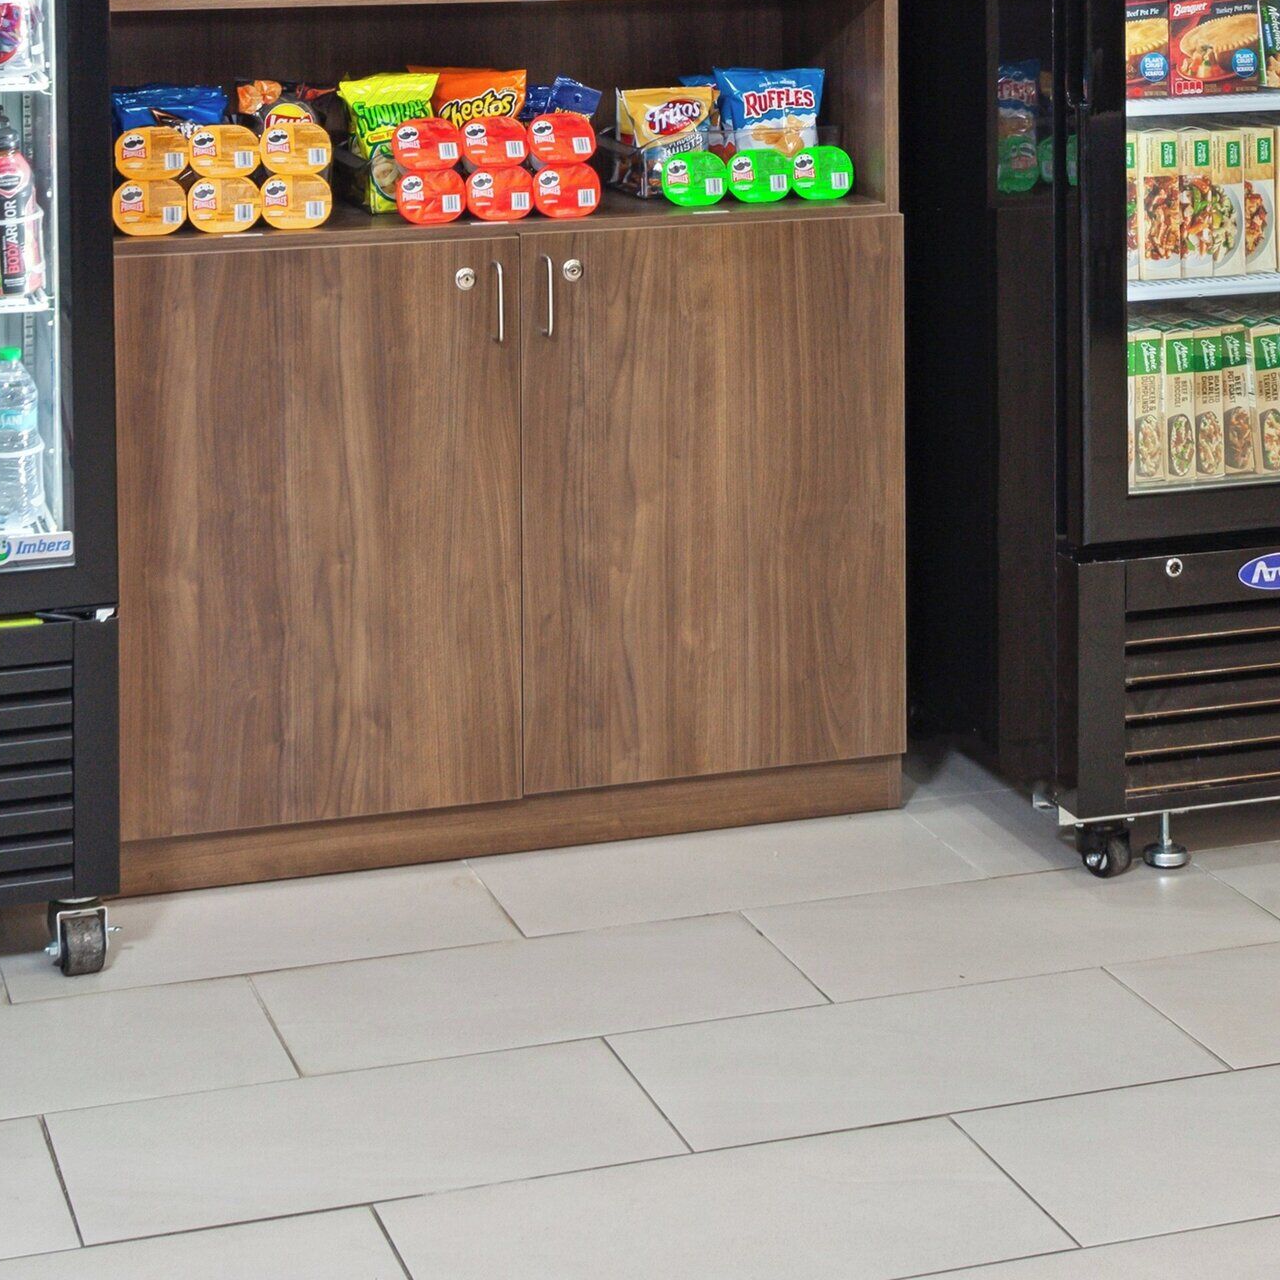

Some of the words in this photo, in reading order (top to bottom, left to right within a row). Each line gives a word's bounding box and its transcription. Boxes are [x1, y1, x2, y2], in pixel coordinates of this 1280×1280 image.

[1140, 8, 1149, 16] Pot
[1150, 7, 1159, 16] Pie
[1173, 2, 1209, 17] Banquet
[438, 89, 515, 130] Cheetos
[744, 88, 815, 119] RUFFLES
[645, 100, 701, 133] Fritos
[15, 537, 72, 556] Imbera
